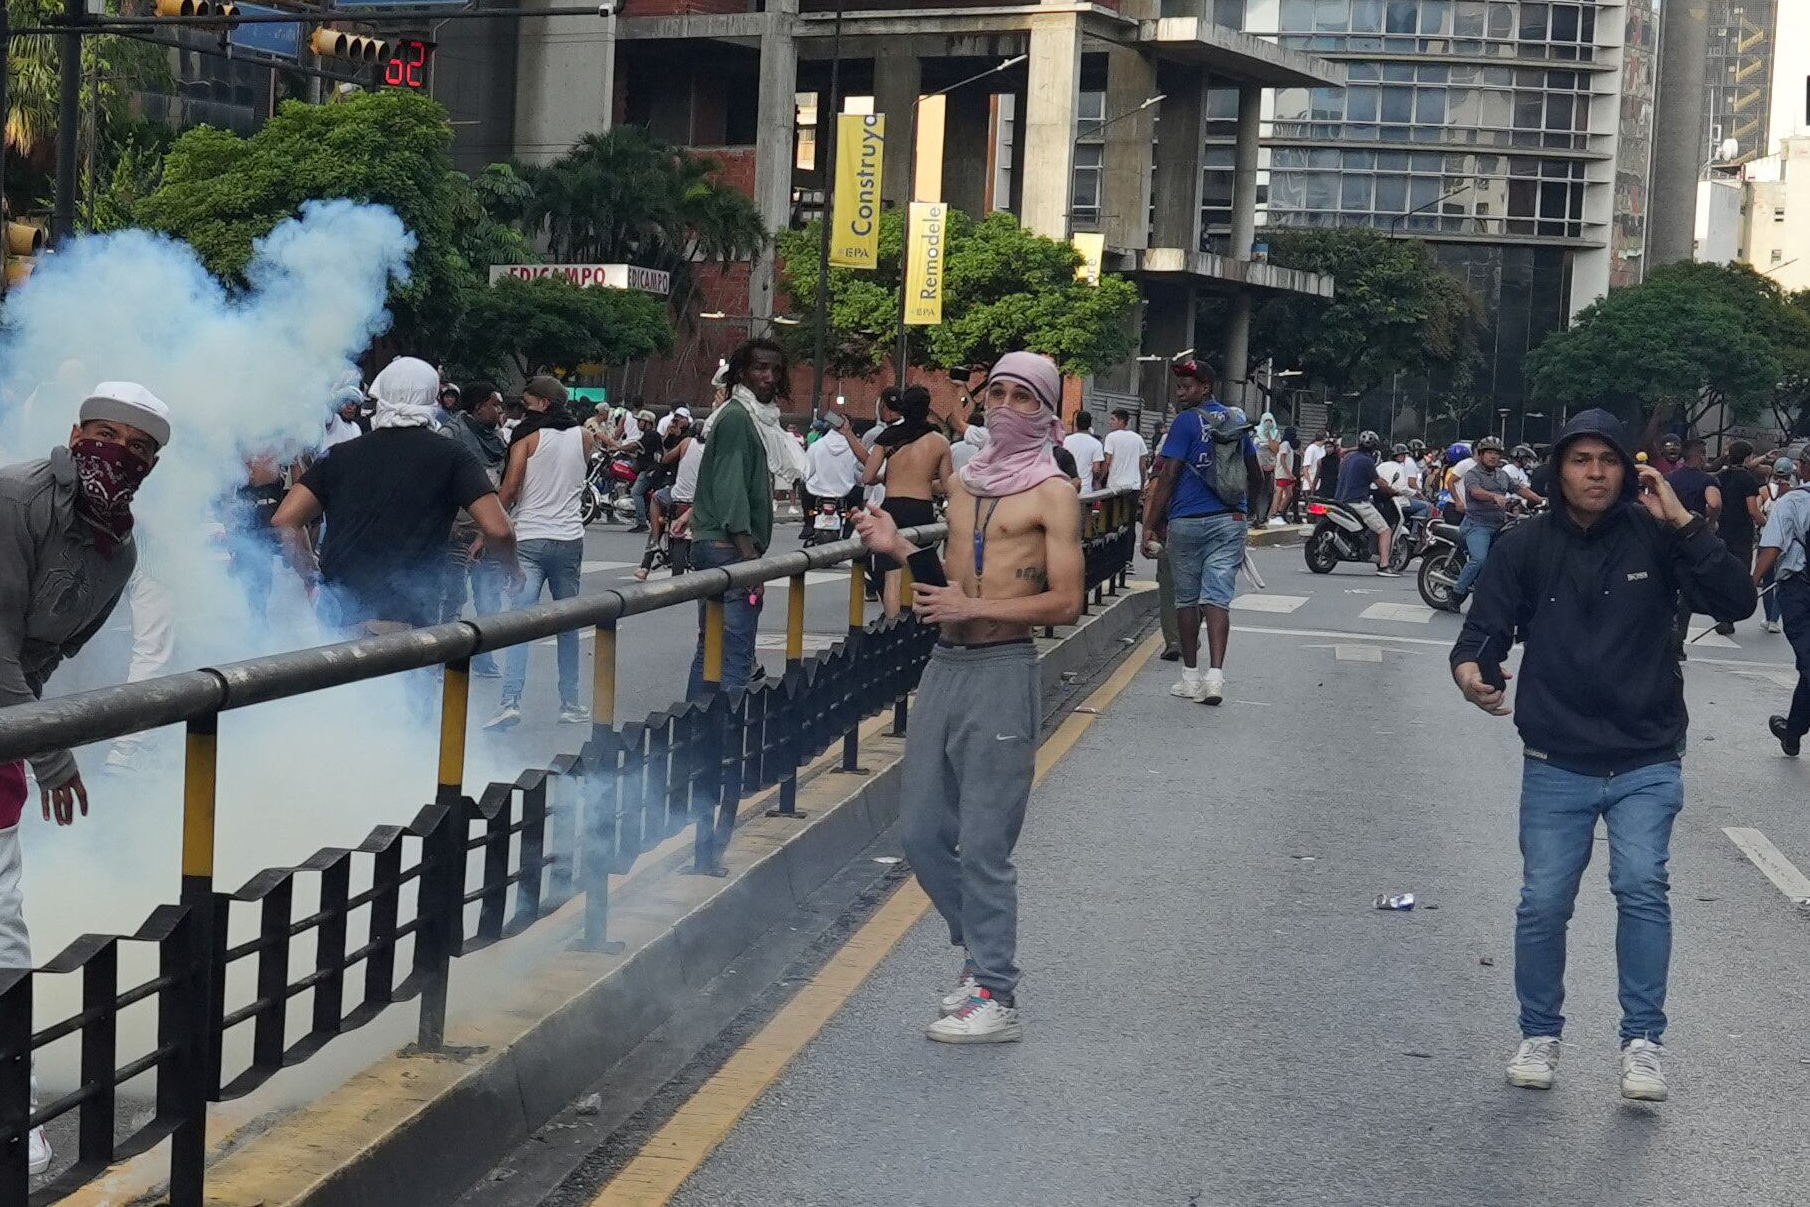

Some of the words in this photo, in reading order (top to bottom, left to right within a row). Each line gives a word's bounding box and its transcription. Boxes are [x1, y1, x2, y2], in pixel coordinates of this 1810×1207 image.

[845, 247, 869, 258] EPA
[920, 206, 941, 299] Remodele
[628, 268, 668, 293] EDICAMPO
